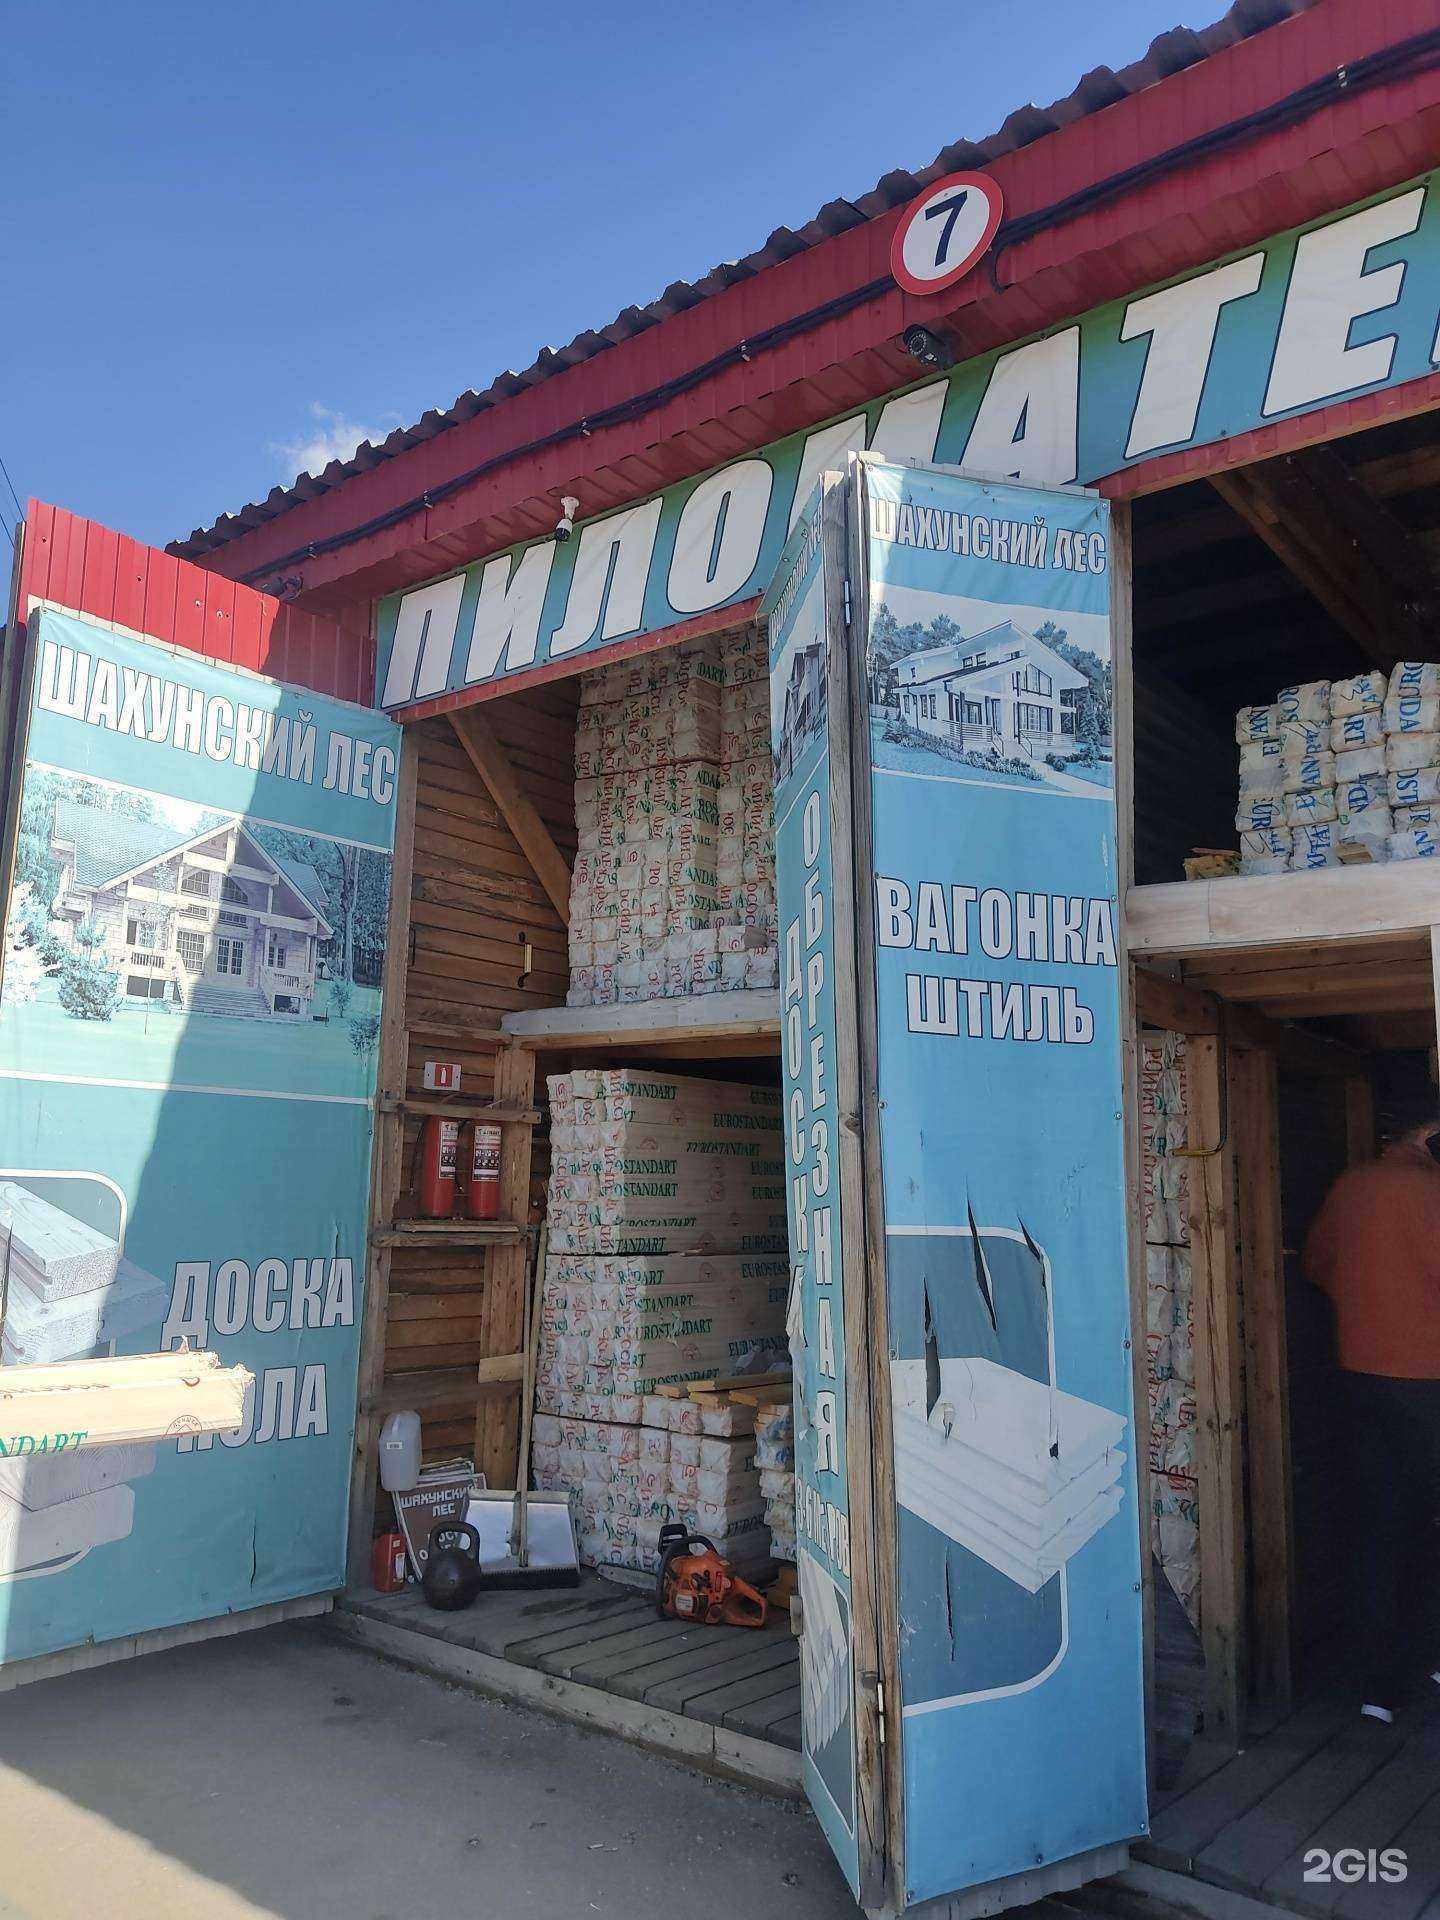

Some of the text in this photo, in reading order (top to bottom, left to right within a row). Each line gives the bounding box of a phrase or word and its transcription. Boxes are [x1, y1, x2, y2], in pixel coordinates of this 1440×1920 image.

[924, 190, 968, 267] 7
[383, 186, 1440, 708] ПИЛОАТЕ
[869, 497, 1107, 576] ШАХУНСКИЙ ЛЕС
[38, 638, 396, 806] ШАХУНСКИЙ ЛЕС
[877, 875, 1118, 968] ВАГОНКА
[904, 972, 1096, 1046] ШТИЛЬ
[160, 1256, 355, 1351] ДОСКА
